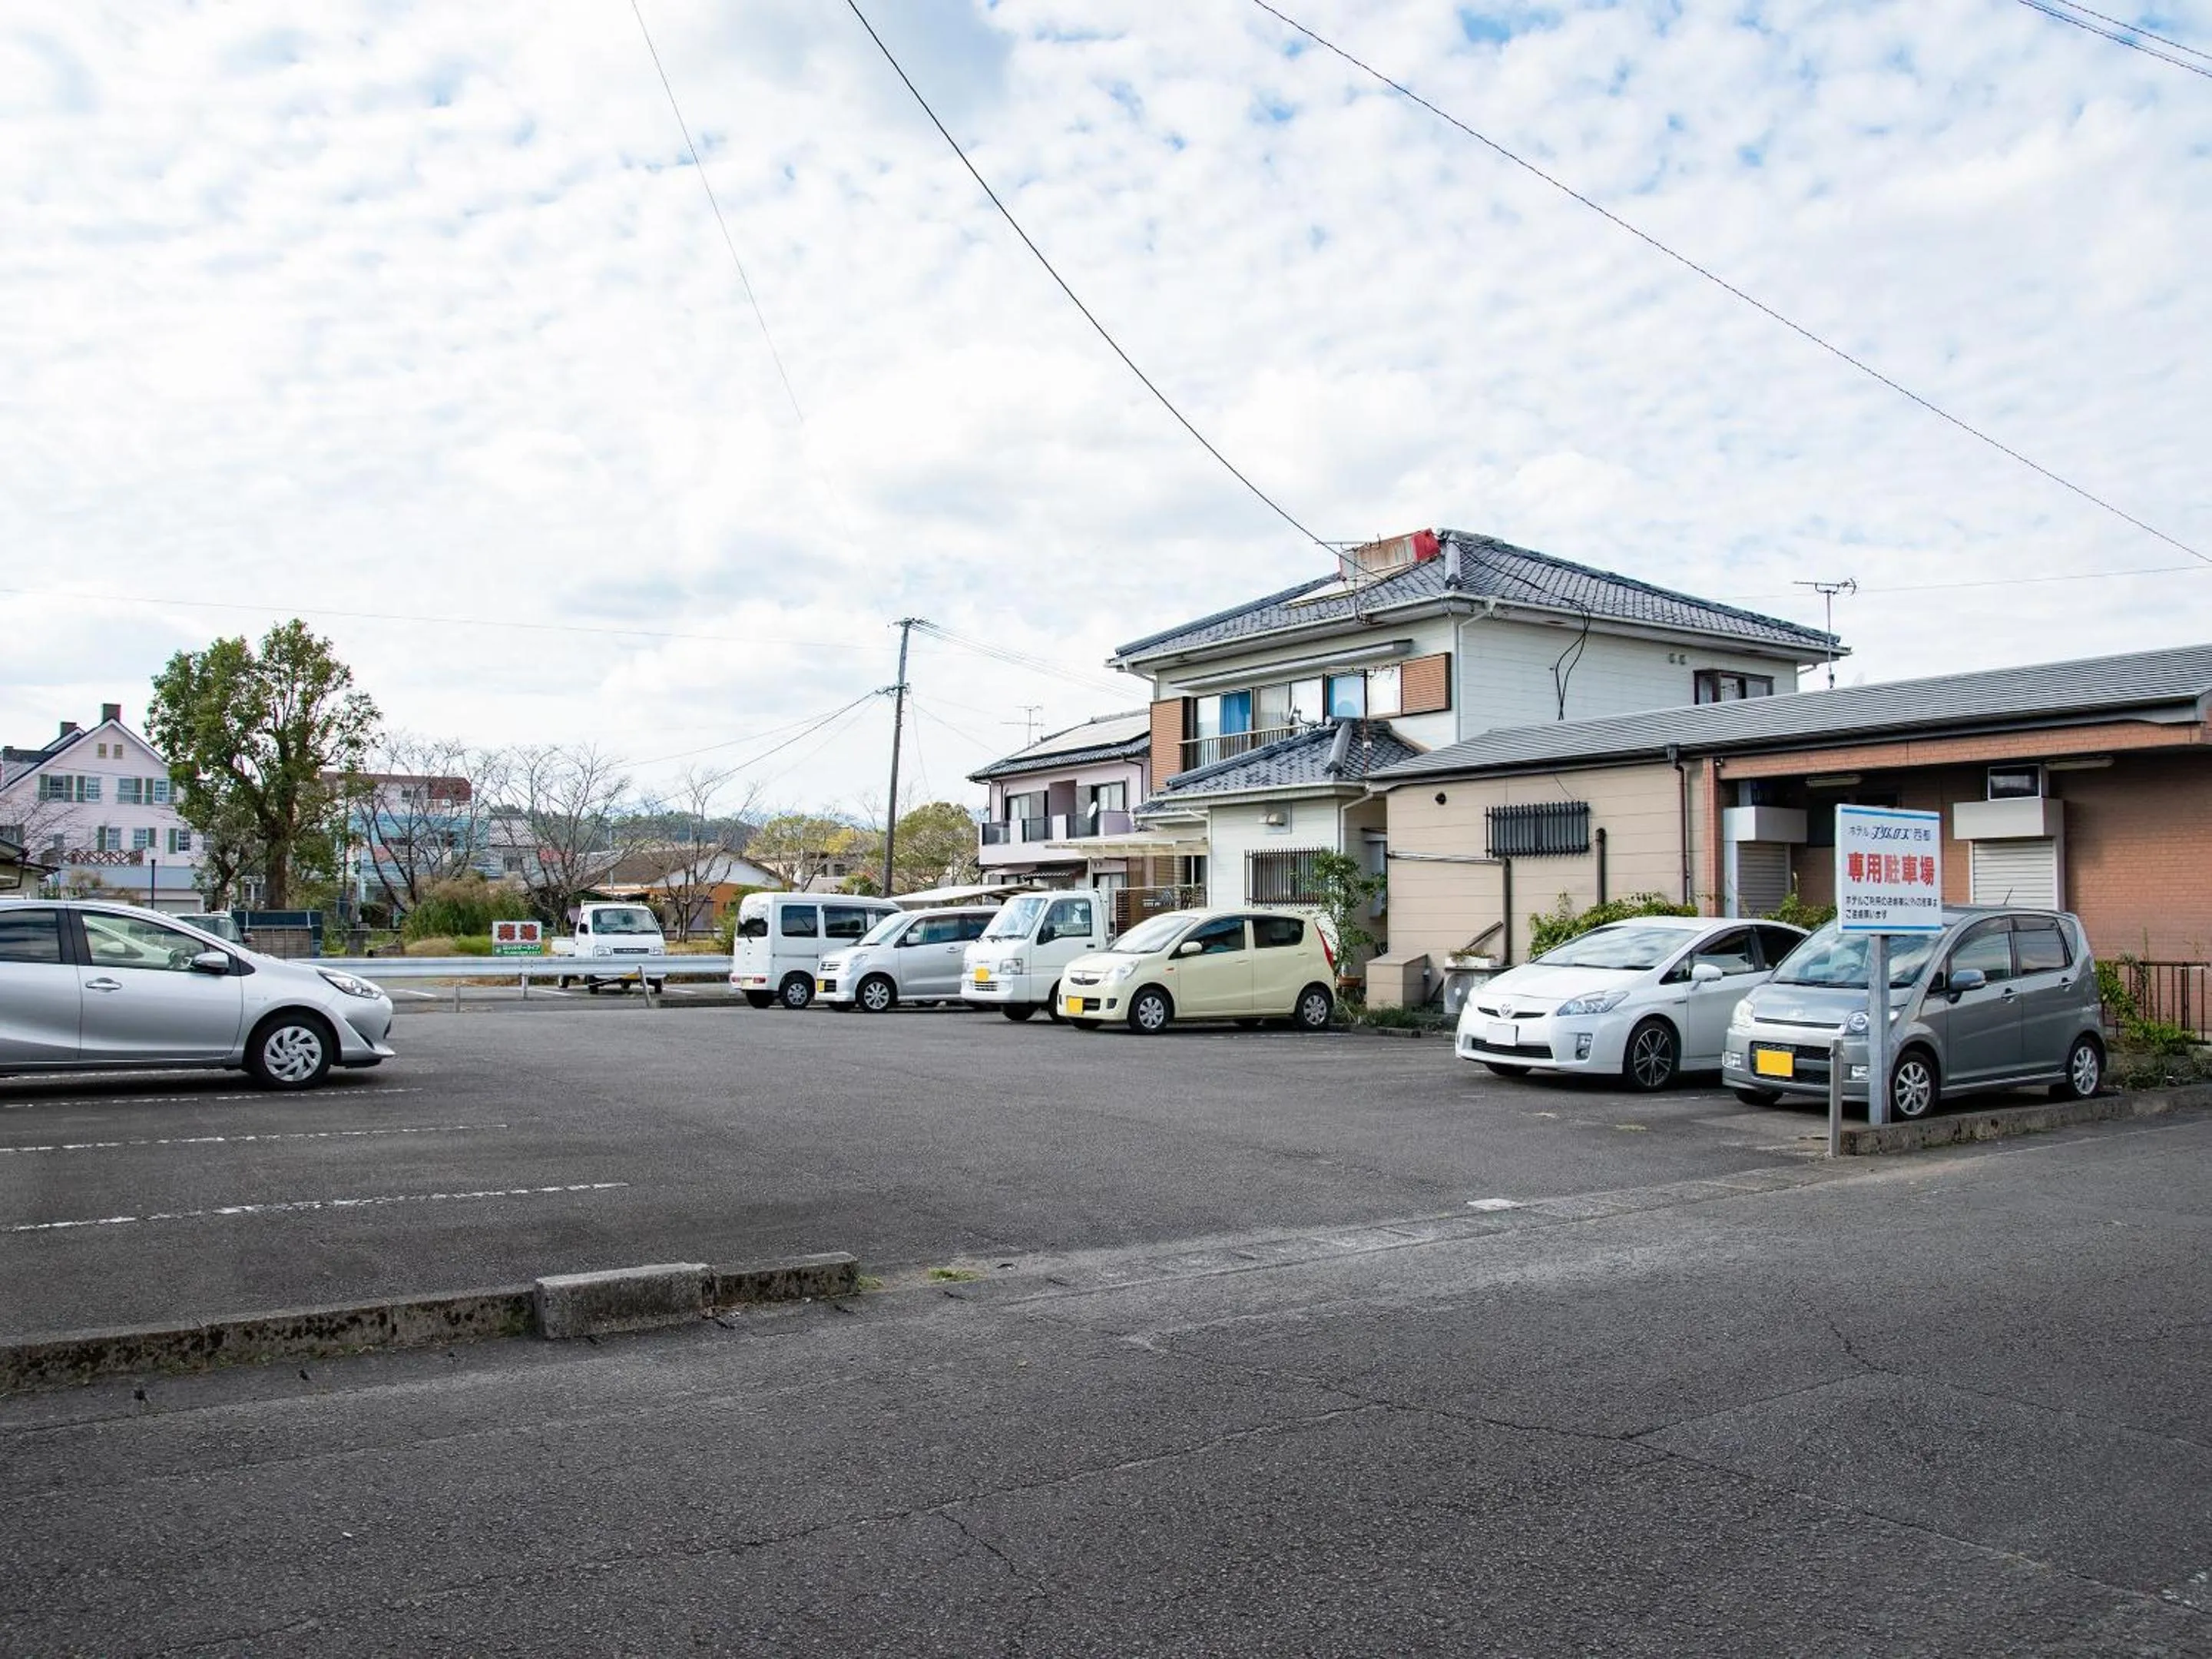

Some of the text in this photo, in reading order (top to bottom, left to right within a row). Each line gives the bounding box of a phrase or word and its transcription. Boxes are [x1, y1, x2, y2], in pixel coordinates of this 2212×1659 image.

[1847, 852, 1936, 886] 専用駐車場
